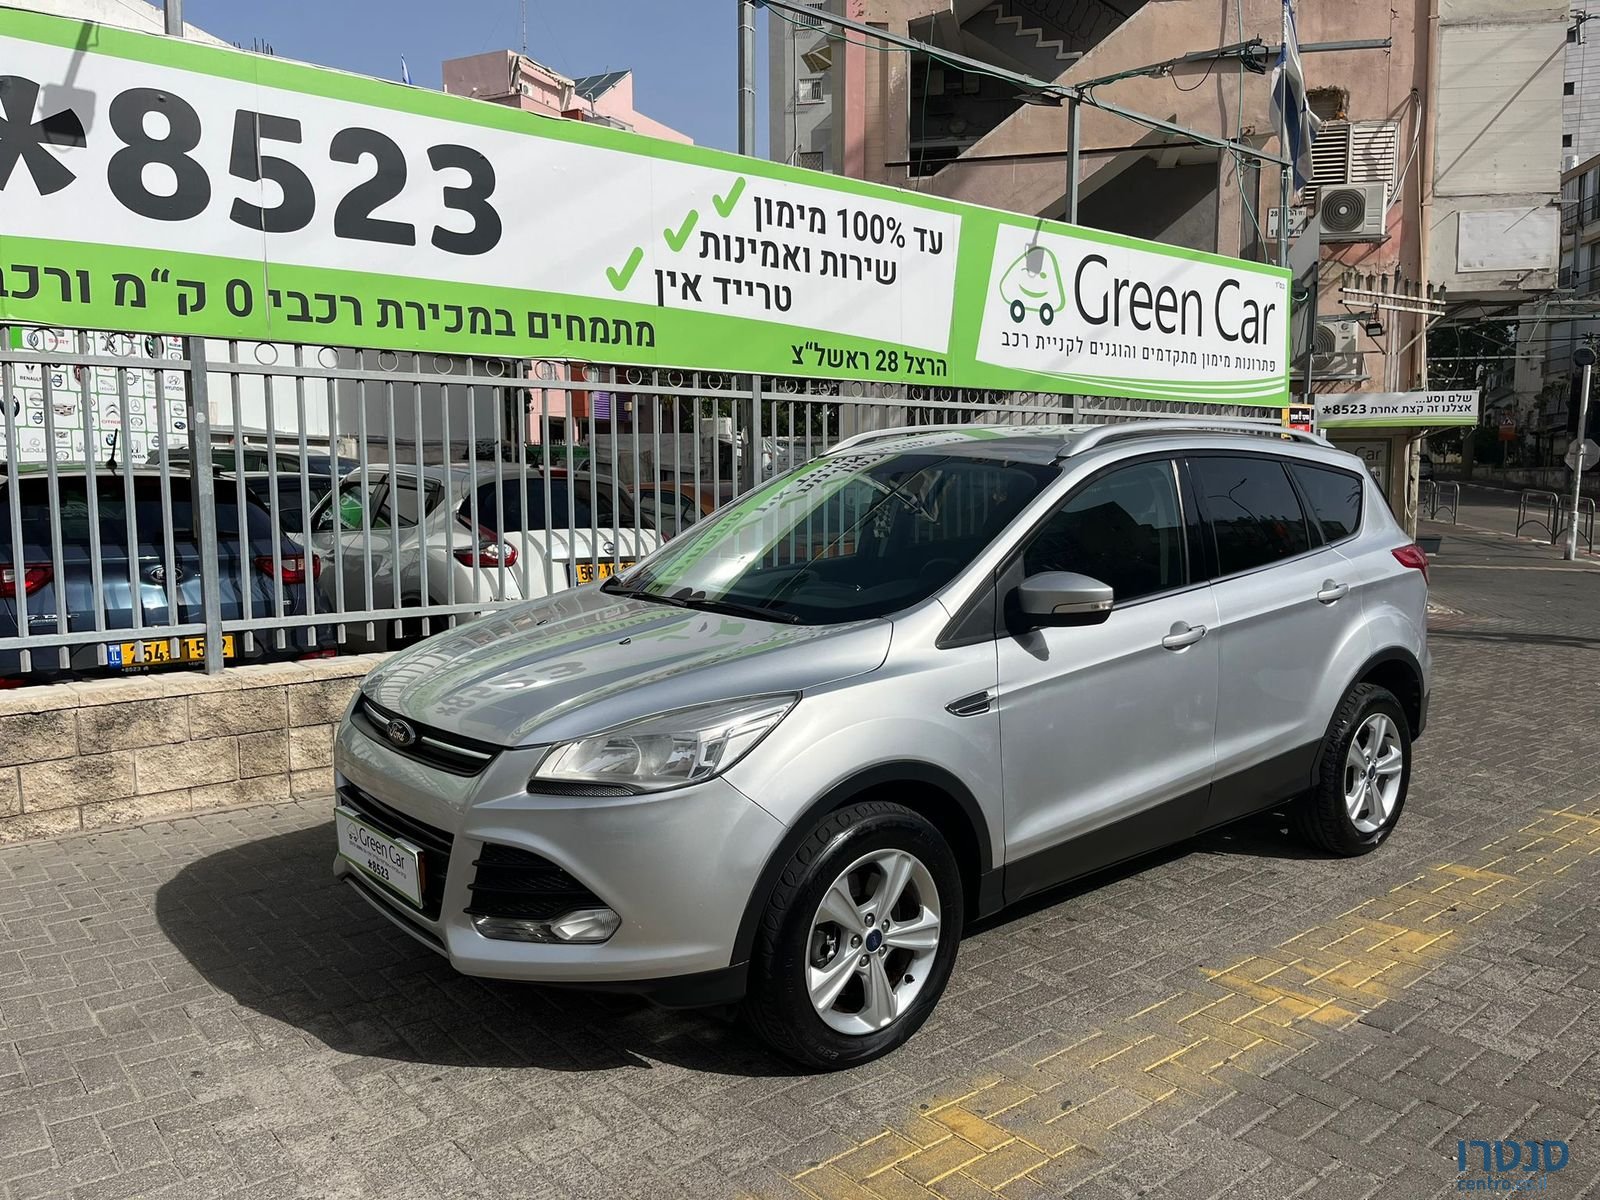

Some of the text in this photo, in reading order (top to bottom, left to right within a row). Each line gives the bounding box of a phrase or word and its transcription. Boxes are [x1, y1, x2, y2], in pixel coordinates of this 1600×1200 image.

[753, 196, 943, 255] עד 100% מימון
[699, 230, 897, 285] שירות ואמינות
[0, 263, 91, 304] ורכ
[225, 278, 253, 318] 0
[655, 269, 792, 312] טרייד אין
[1074, 254, 1276, 345] Green Car
[267, 289, 363, 326] רכבי
[376, 298, 516, 337] במכירת
[527, 311, 655, 348] מתמחים
[876, 350, 899, 373] 28
[904, 351, 947, 376] הרצל
[1001, 331, 1276, 373] פתרונות מימון מתקדמים והוגנים לקניית רכב
[1369, 406, 1399, 414] אחרת
[1401, 405, 1424, 415] קצת
[1415, 393, 1472, 404] שלם וסע...
[1427, 405, 1439, 413] זה
[1442, 403, 1472, 413] אצלנו
[1354, 446, 1382, 461] Car
[388, 722, 406, 743] Ford
[359, 827, 388, 859] Green
[388, 845, 405, 869] Car
